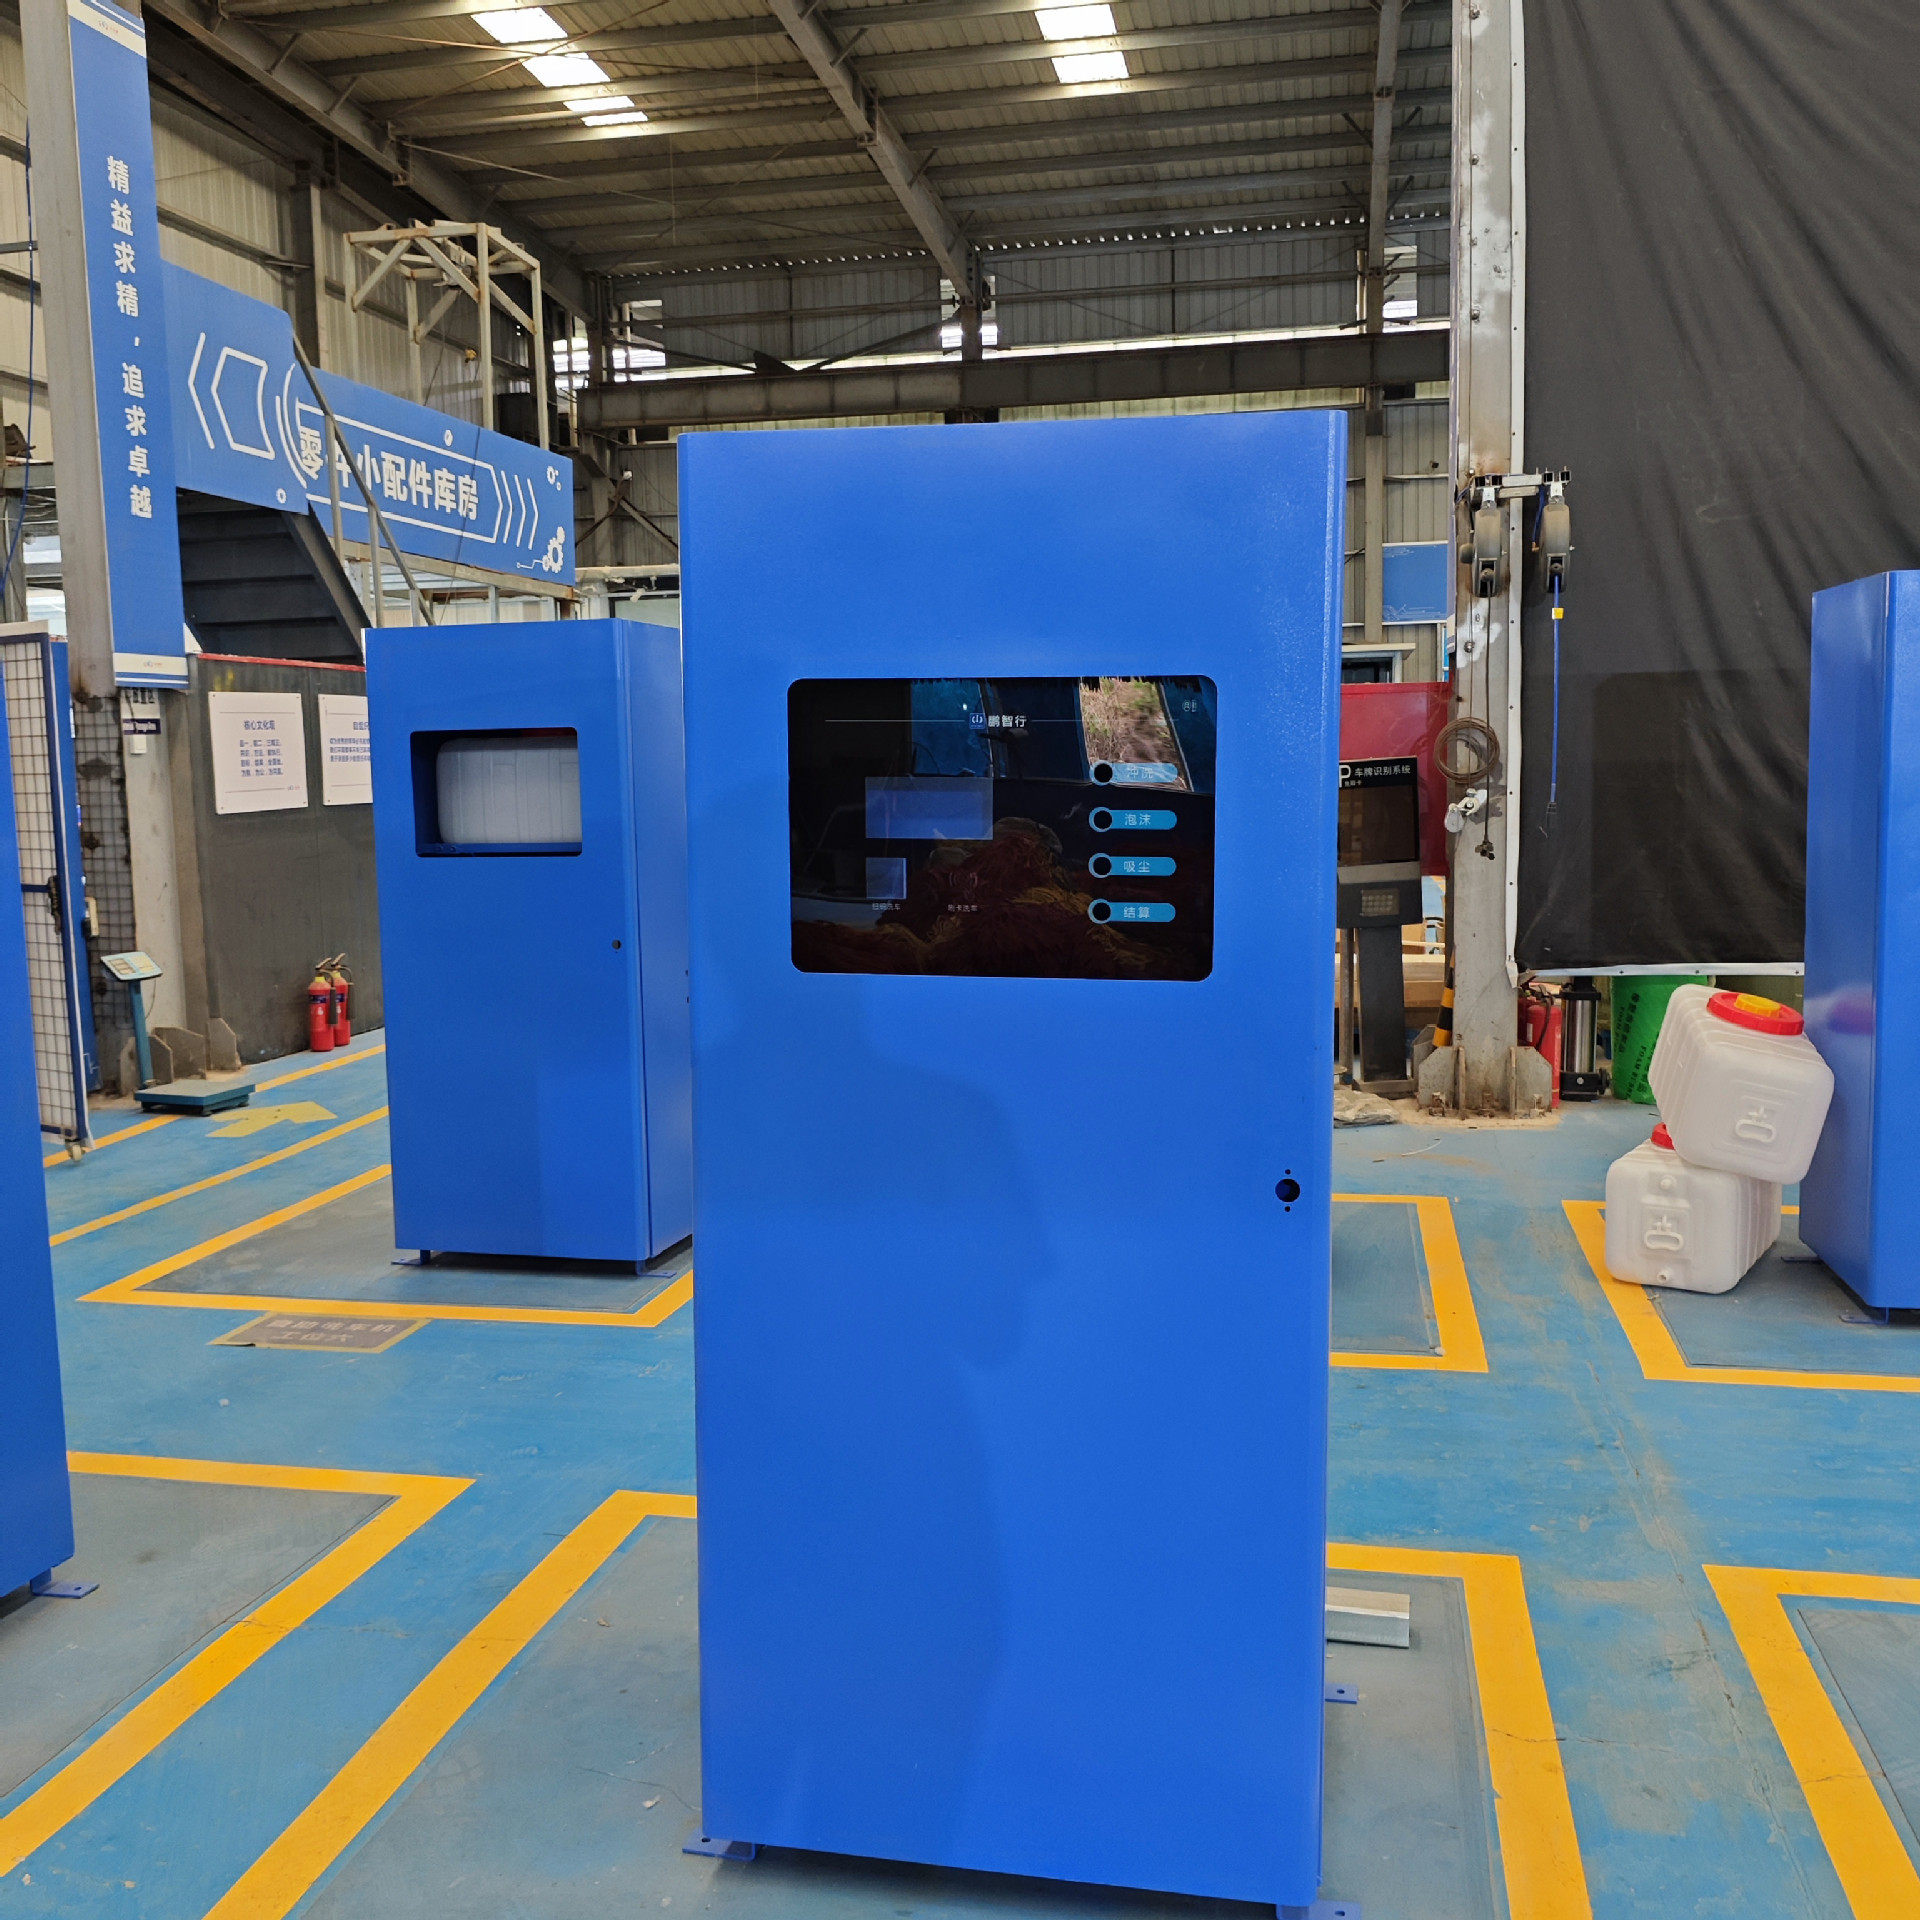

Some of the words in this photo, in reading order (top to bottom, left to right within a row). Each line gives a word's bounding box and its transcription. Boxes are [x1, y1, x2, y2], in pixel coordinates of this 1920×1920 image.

[1339, 764, 1351, 788] P
[1354, 764, 1411, 778] 车牌识别系统
[1124, 813, 1152, 827] 泡沫
[1123, 860, 1151, 873] 吸尘
[1123, 906, 1151, 919] 结算
